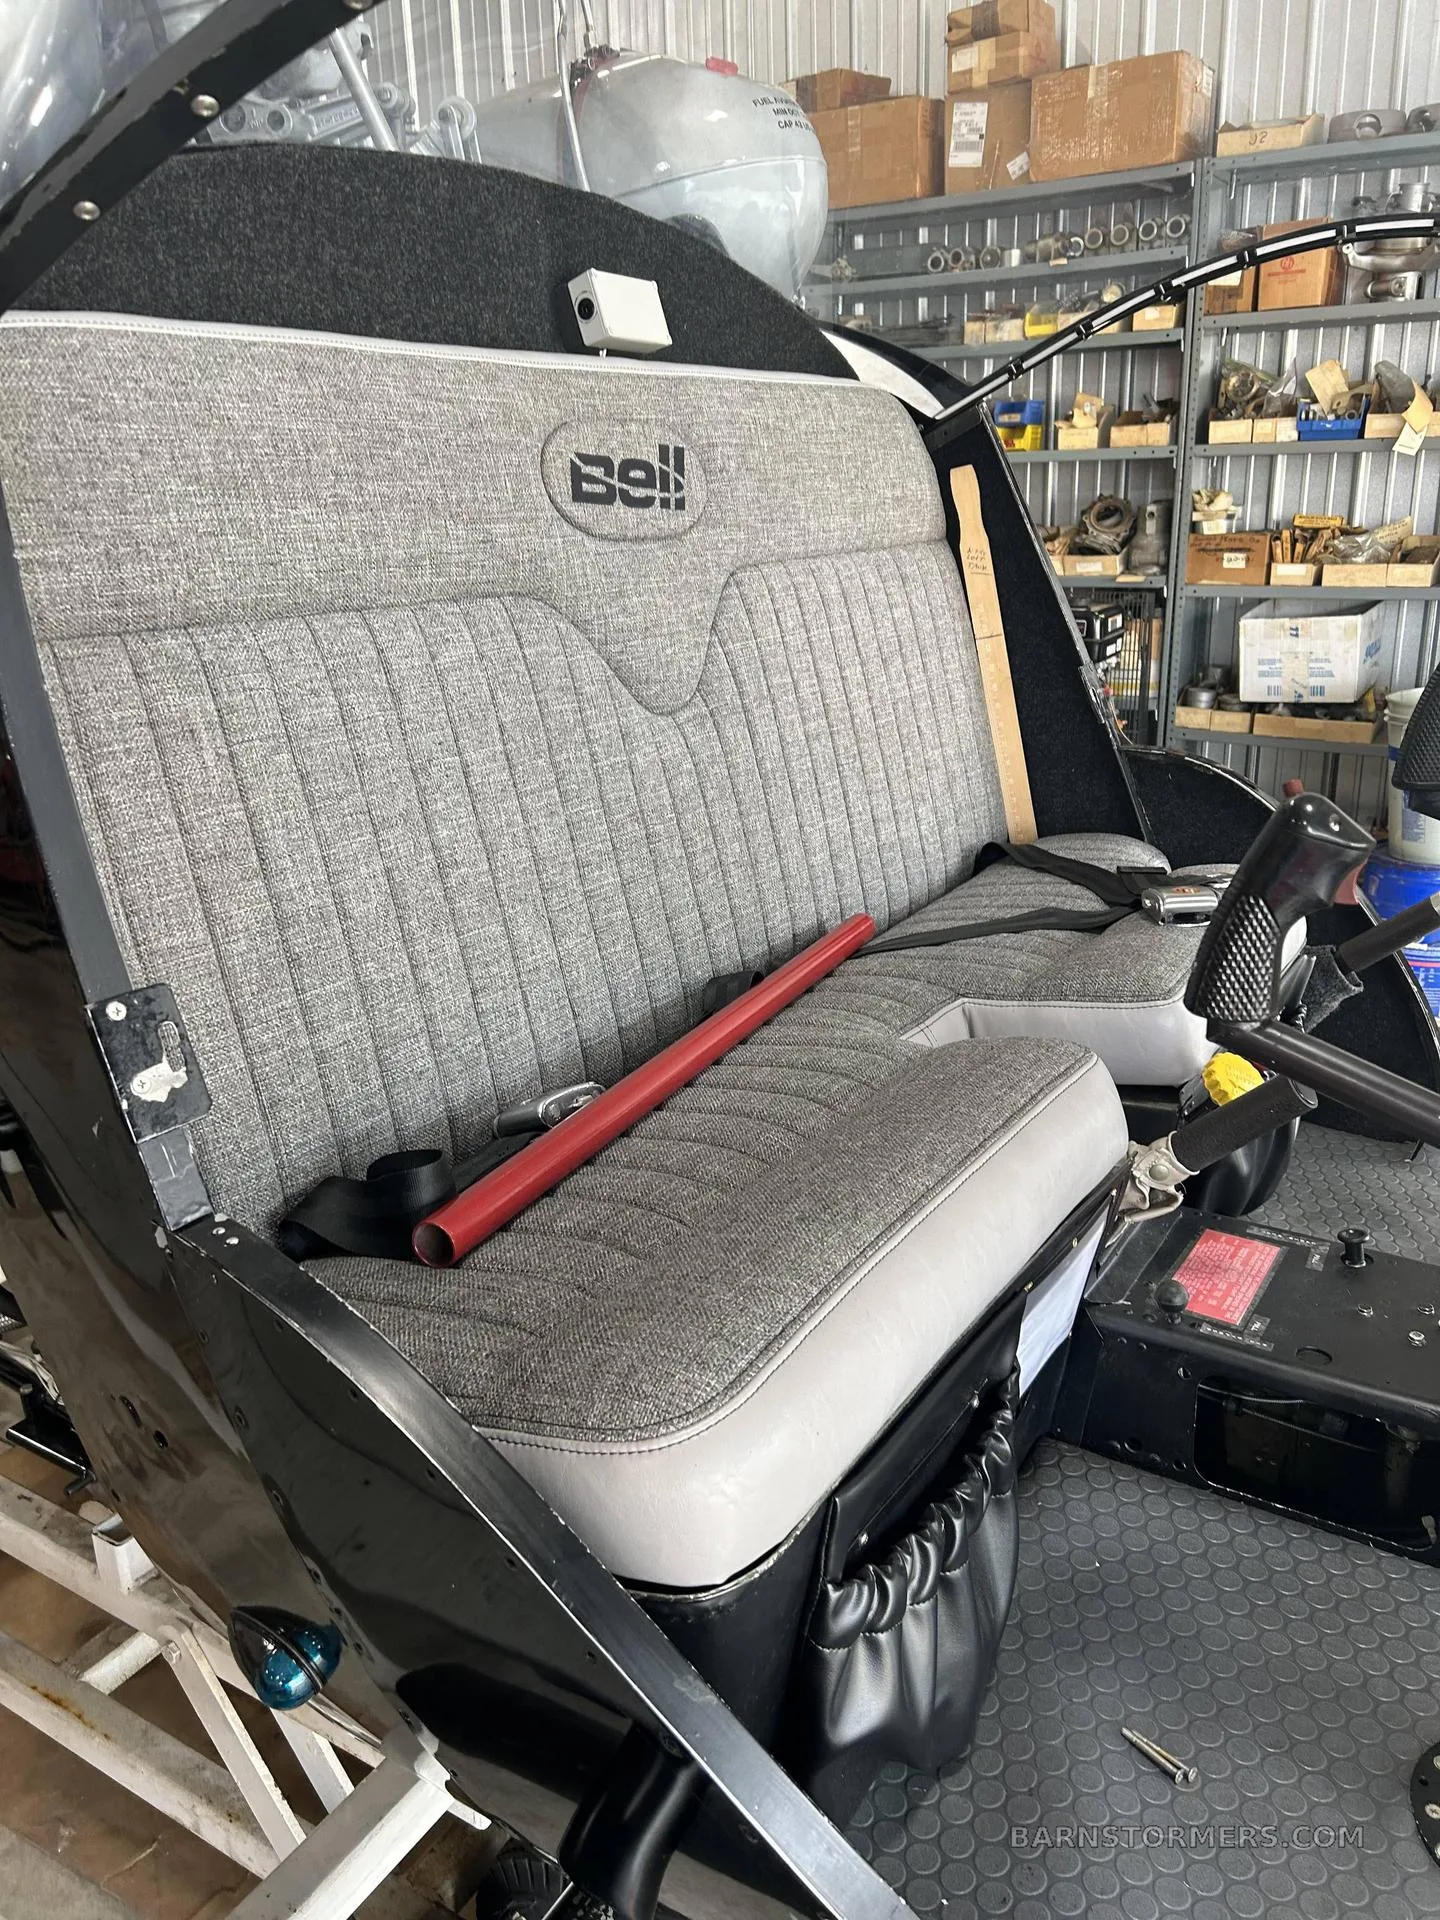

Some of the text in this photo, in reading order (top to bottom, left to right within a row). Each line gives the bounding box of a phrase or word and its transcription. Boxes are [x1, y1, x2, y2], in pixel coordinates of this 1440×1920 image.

[752, 96, 774, 108] FUEL
[777, 119, 793, 129] CAP
[569, 443, 686, 511] Bell
